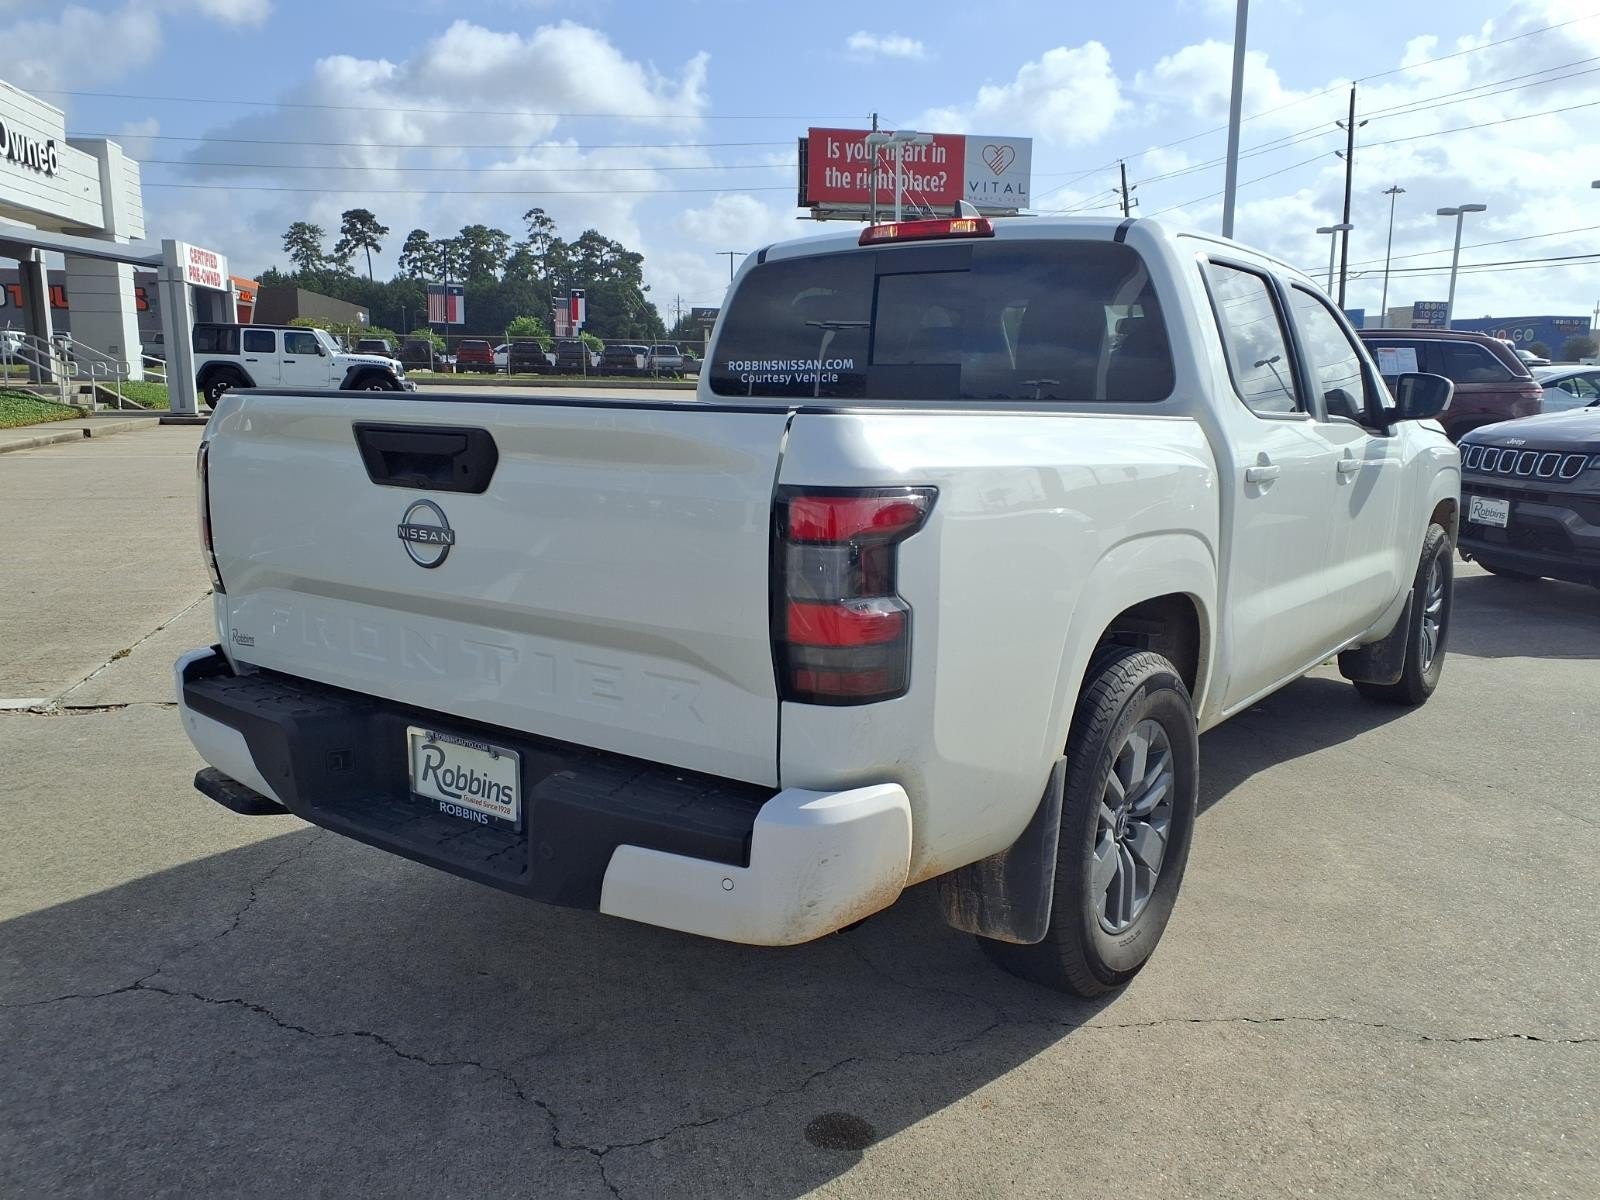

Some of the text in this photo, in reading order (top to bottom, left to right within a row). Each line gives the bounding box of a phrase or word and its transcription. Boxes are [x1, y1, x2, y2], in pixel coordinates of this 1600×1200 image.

[827, 136, 840, 159] Is
[932, 142, 946, 163] in
[825, 167, 851, 189] the
[900, 169, 947, 193] place?
[969, 181, 1026, 195] VITAL
[189, 247, 218, 269] CERTIFIED
[188, 265, 221, 287] PRE-OWNED
[1420, 310, 1445, 319] TO GO
[1512, 328, 1535, 342] GO
[728, 359, 854, 371] ROBBINSNISSAN.COM
[741, 372, 839, 385] Courtesy Vehicle
[1473, 502, 1506, 519] Robbins
[398, 526, 452, 543] NISSAN
[421, 743, 513, 805] Robbins
[440, 802, 489, 825] ROBBINS
[463, 794, 483, 806] Trusted
[498, 804, 512, 815] 1928
